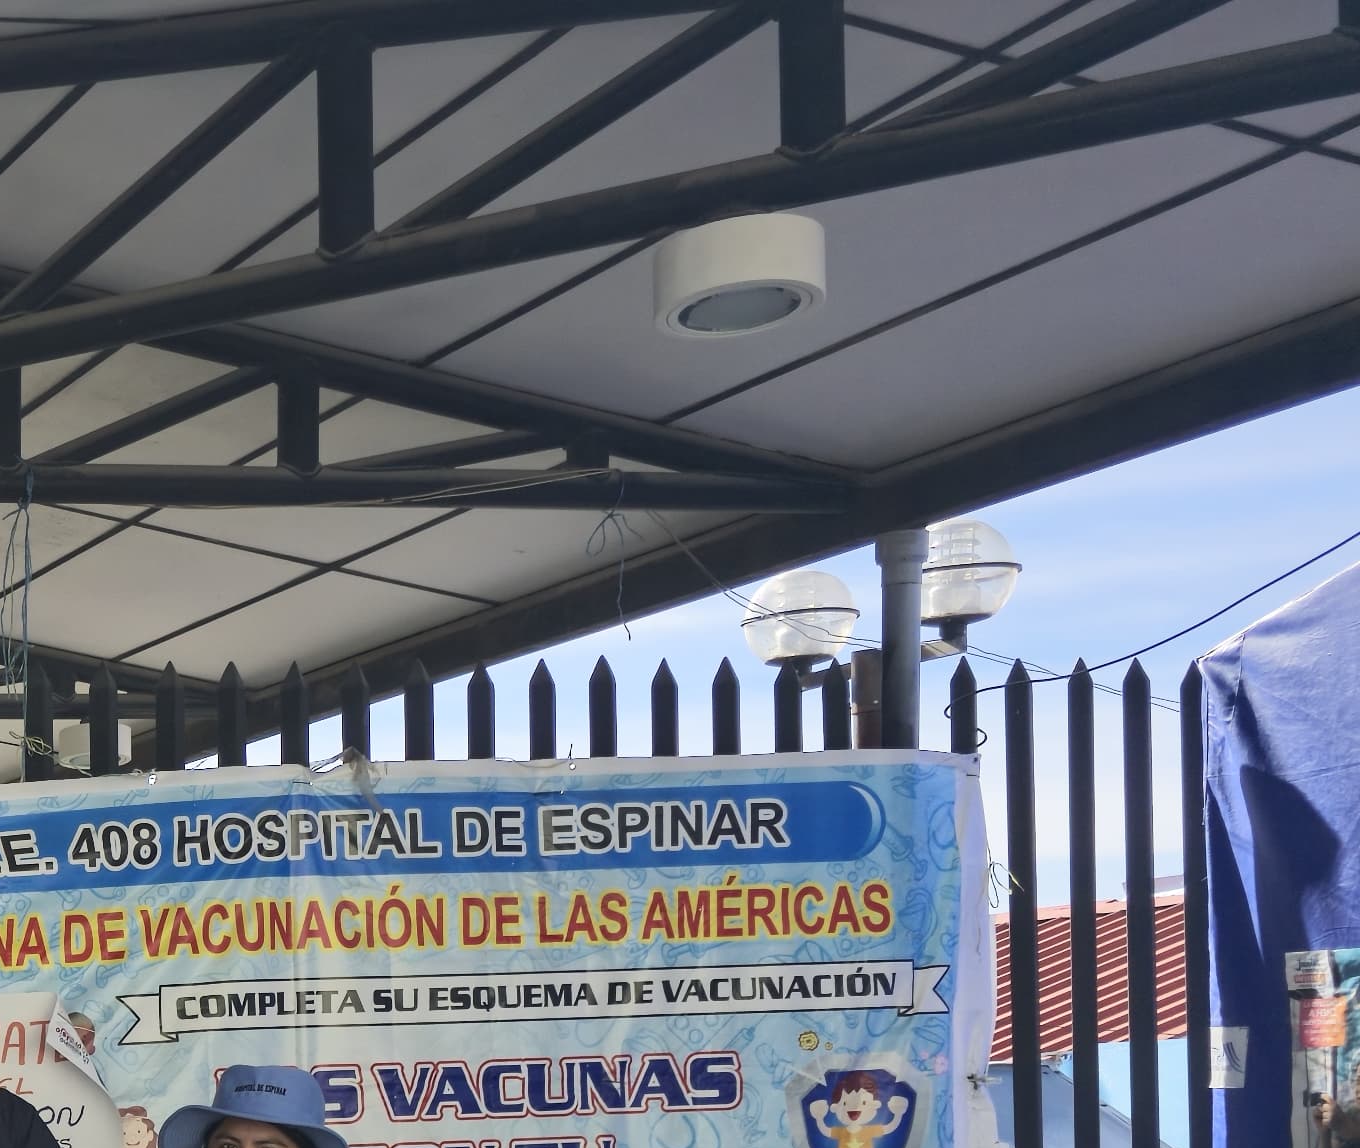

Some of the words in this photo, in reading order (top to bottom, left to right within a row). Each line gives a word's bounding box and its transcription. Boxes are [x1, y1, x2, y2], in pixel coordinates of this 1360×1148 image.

[70, 819, 162, 872] 408
[174, 805, 438, 868] HOSPITAL
[452, 807, 526, 859] DE
[538, 799, 791, 855] ESPINAR
[63, 910, 127, 964] DE
[139, 884, 446, 958] VACUNACIÓN
[462, 896, 526, 947] DE
[538, 893, 630, 944] LAS
[641, 875, 894, 940] AMÉRICAS
[174, 986, 367, 1021] COMPLETA
[372, 988, 420, 1013] SU
[428, 981, 597, 1012] ESQUEMA
[607, 980, 654, 1005] DE
[661, 965, 897, 1002] VACUNACIÓN
[372, 1051, 744, 1123] VACUNAS
